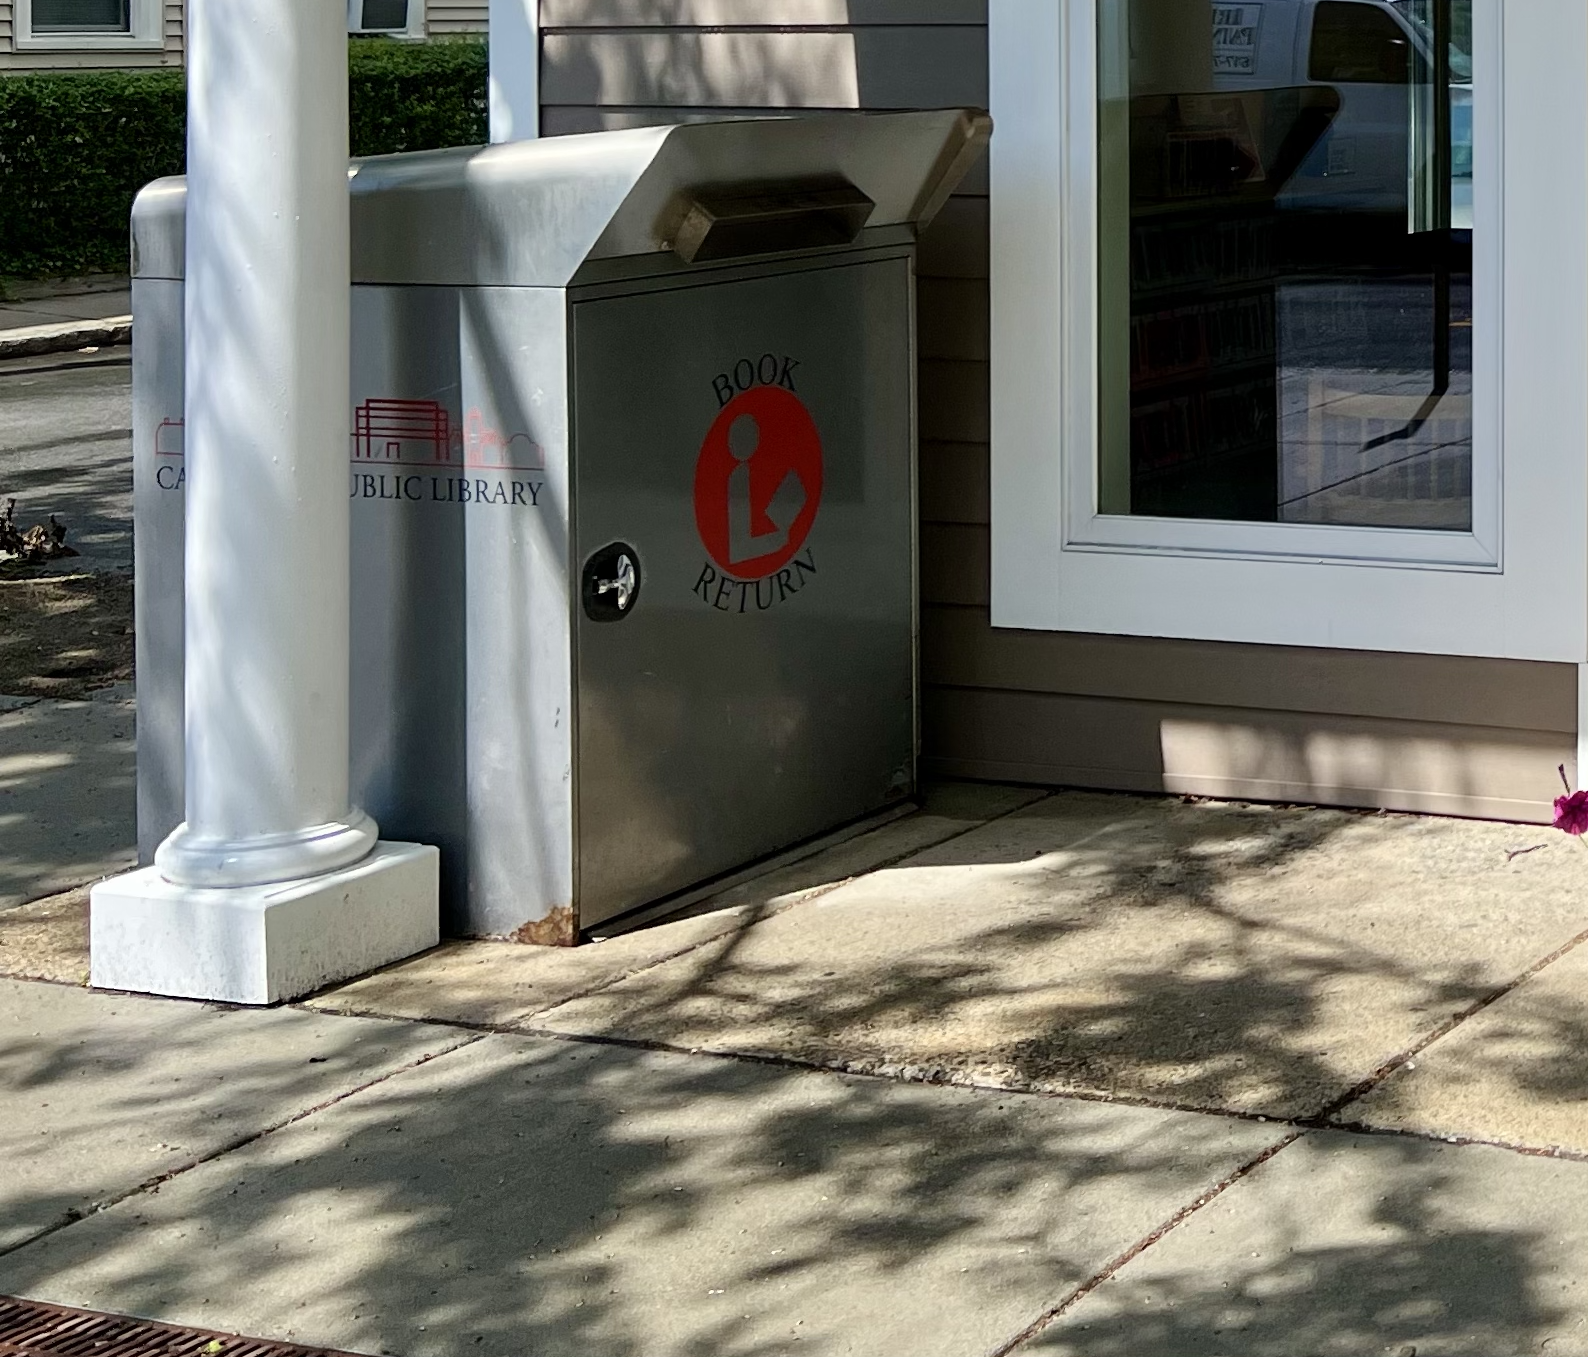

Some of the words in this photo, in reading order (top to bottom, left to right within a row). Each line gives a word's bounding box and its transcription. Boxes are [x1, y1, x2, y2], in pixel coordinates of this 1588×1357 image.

[711, 353, 801, 409] BOOK
[350, 473, 423, 501] UBLIC
[431, 477, 544, 507] LIBRARY
[691, 546, 818, 614] RETURN
